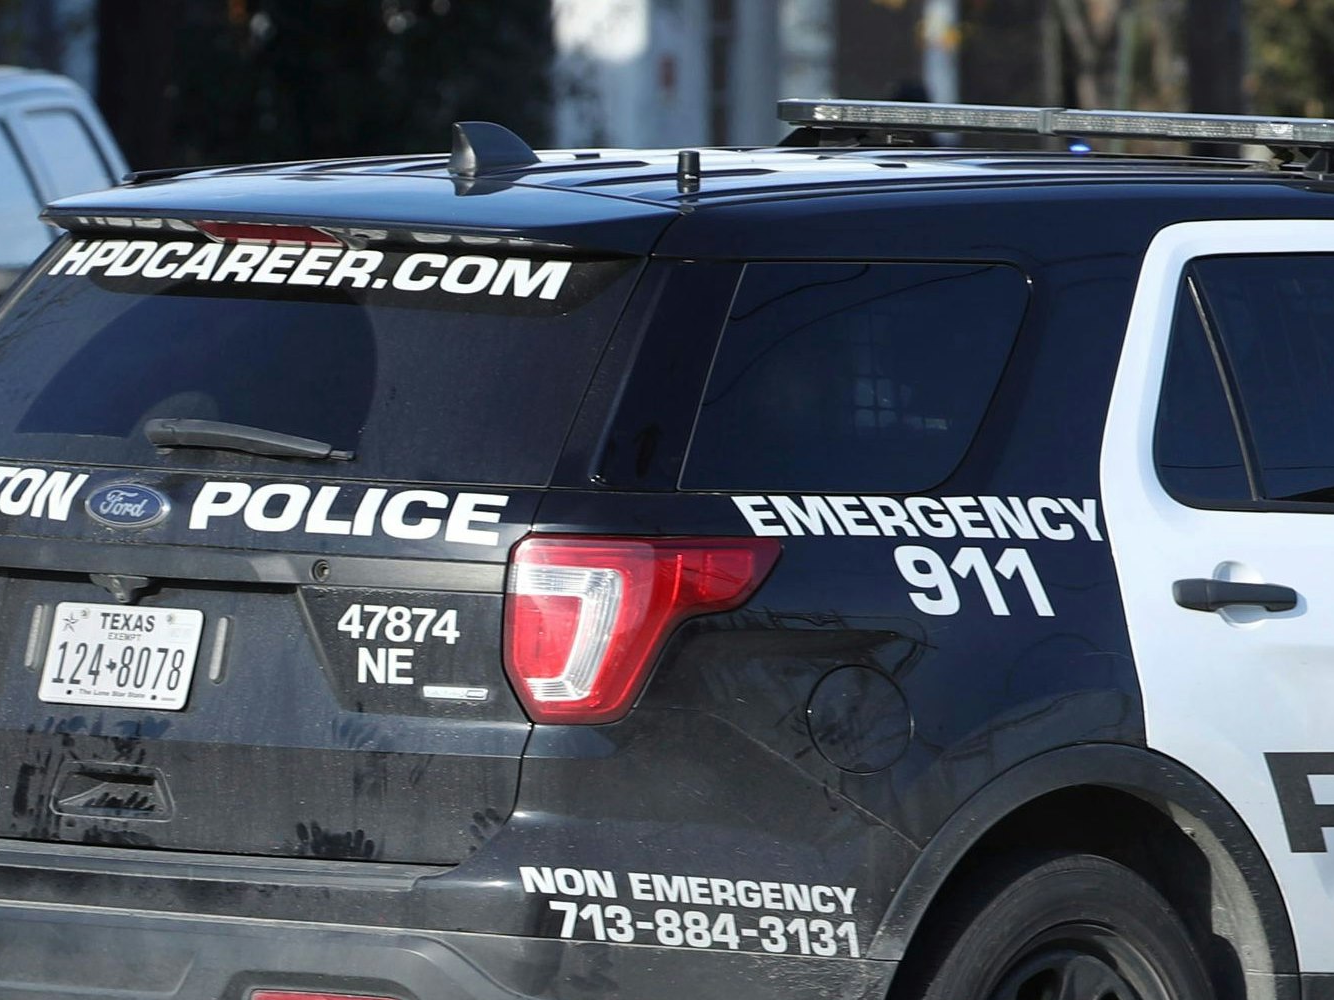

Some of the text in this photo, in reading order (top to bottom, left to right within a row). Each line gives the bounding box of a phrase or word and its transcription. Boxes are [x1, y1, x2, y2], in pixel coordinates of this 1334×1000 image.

[48, 240, 573, 300] HPDCAREER.COM
[99, 489, 148, 517] Ford
[188, 481, 510, 546] POLICE
[730, 495, 1105, 541] EMERGENCY
[893, 545, 1056, 617] 911
[100, 612, 156, 633] TEXAS
[107, 632, 142, 642] EXEMPT
[337, 603, 461, 645] 47874
[357, 647, 414, 685] NE
[519, 866, 858, 915] NON EMERGENCY
[549, 900, 861, 959] 713-884-3131
